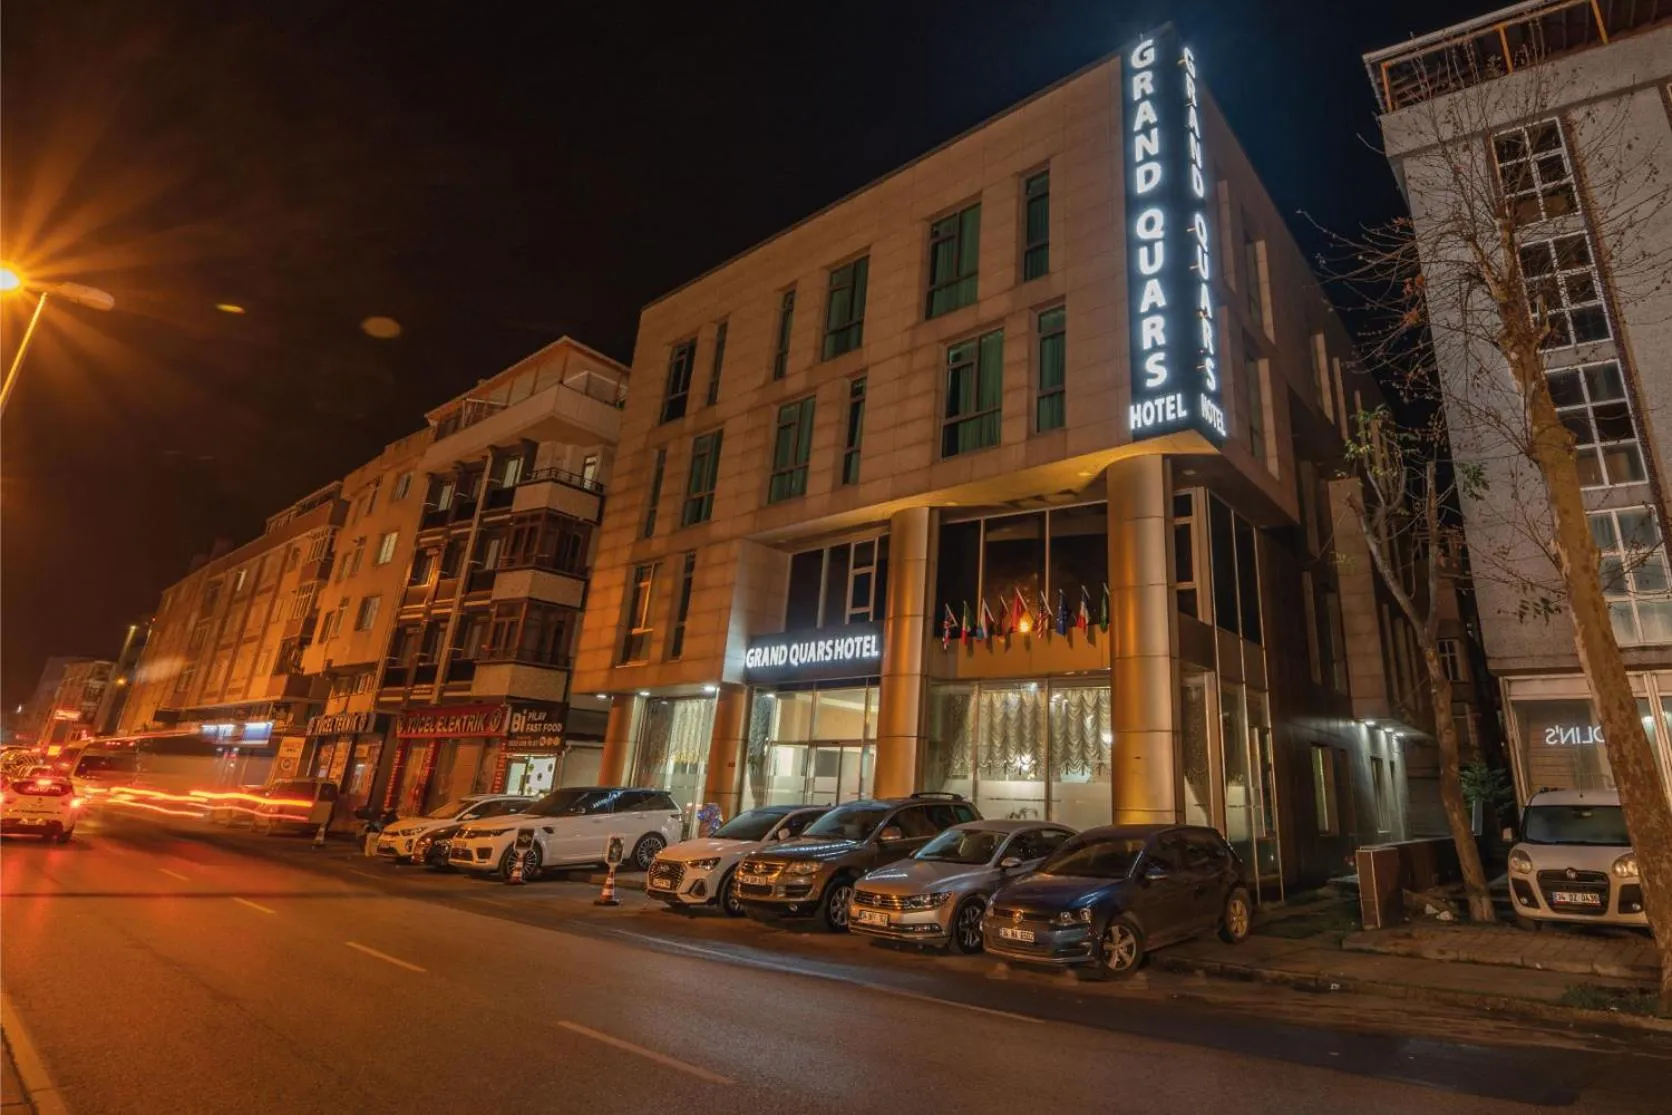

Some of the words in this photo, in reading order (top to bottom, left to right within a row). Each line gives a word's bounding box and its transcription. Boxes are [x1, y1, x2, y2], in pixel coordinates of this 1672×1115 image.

[1131, 38, 1162, 194] GRAND
[1183, 46, 1205, 198] GRAND
[1194, 212, 1216, 392] QUARS
[1136, 208, 1168, 388] QUARS
[1129, 394, 1188, 430] HOTEL
[1200, 393, 1227, 437] HOTEL
[746, 644, 788, 668] GRAND
[789, 639, 833, 666] QUARS
[834, 635, 879, 660] HOTEL
[525, 723, 542, 732] FAST
[542, 722, 562, 732] FOOD
